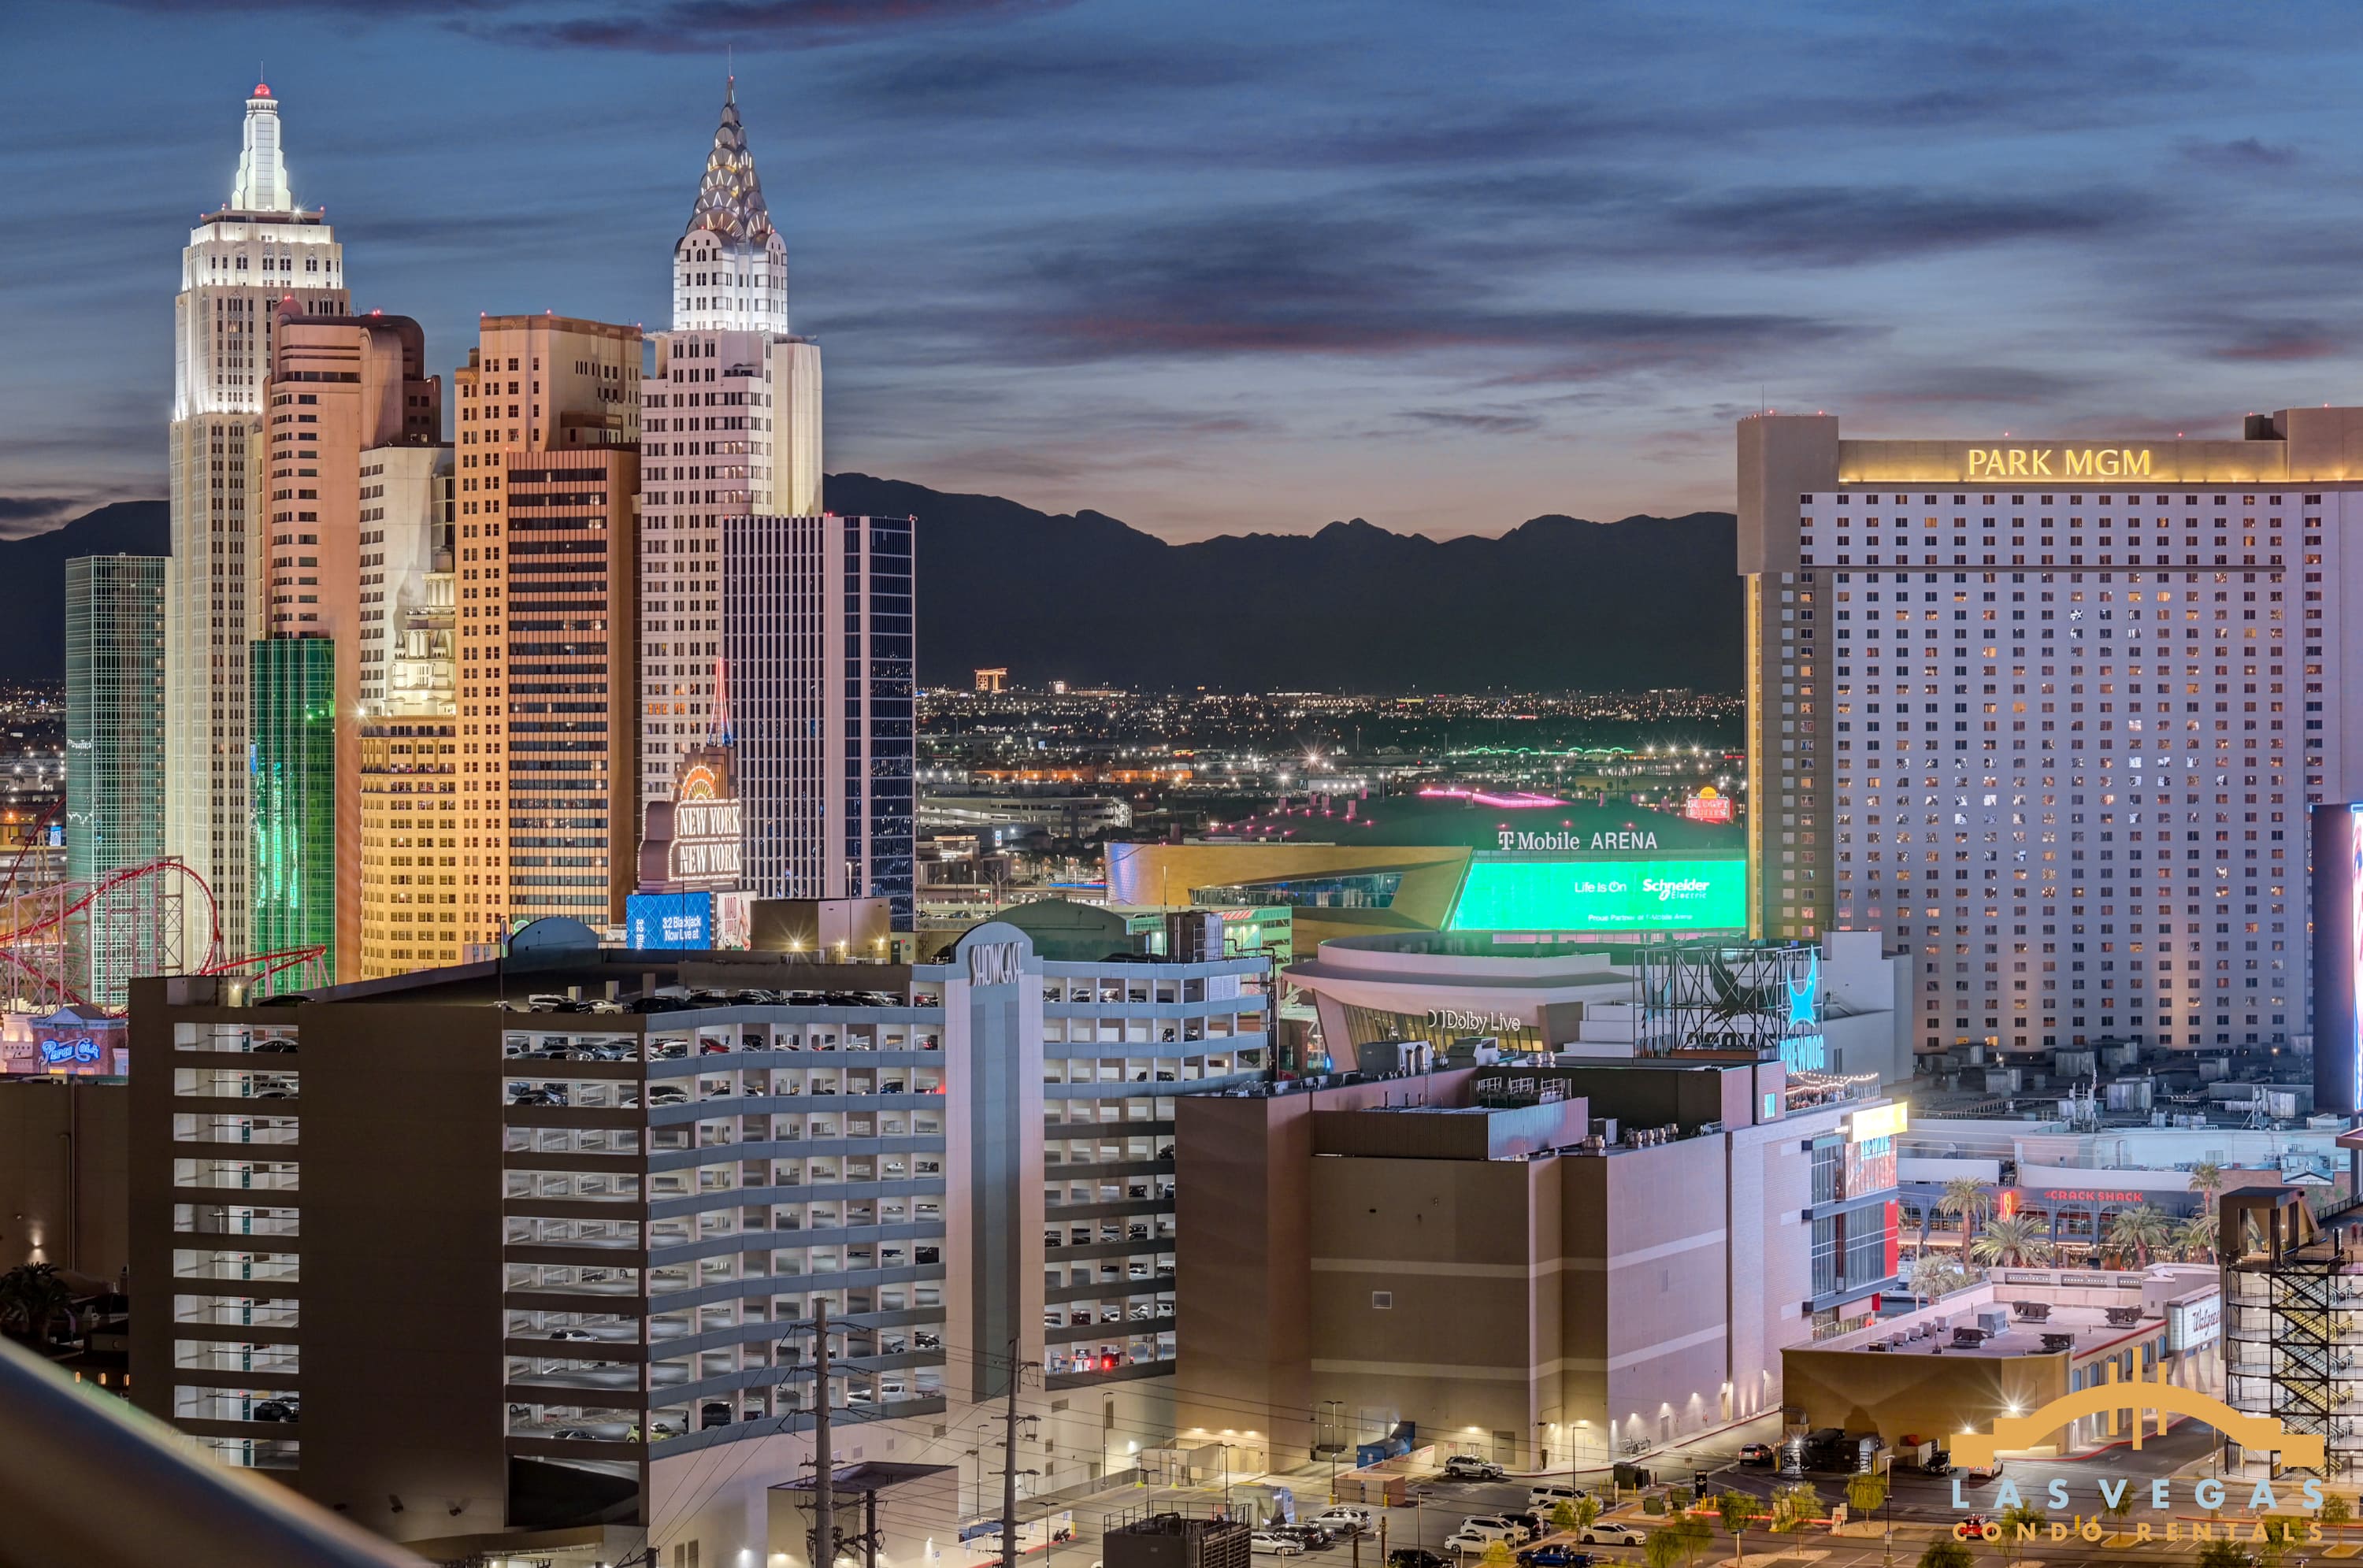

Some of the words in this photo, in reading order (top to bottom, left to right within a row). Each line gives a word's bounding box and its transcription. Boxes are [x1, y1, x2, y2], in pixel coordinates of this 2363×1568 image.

[1968, 449, 2053, 476] PARK
[2065, 449, 2150, 476] MGM
[680, 807, 707, 836] NEW
[709, 806, 741, 834] YORK
[1517, 831, 1580, 851] Mobile
[1590, 832, 1658, 850] ARENA
[680, 844, 707, 874] NEW
[710, 843, 741, 871] YORK
[1575, 882, 1595, 893] Life
[1597, 882, 1606, 892] Is
[1608, 881, 1627, 892] On
[1642, 878, 1710, 892] Schneider
[724, 896, 737, 920] MAD
[662, 916, 673, 929] 3:2
[665, 929, 679, 941] Now
[680, 929, 692, 940] Lve
[692, 928, 699, 939] at
[972, 942, 1024, 987] SHOWCASE
[1446, 1010, 1487, 1035] Dolby
[1490, 1012, 1520, 1032] Live
[1780, 1034, 1824, 1075] BREWDOG
[2051, 1190, 2095, 1202] CRACK
[2098, 1190, 2143, 1203] SHACK
